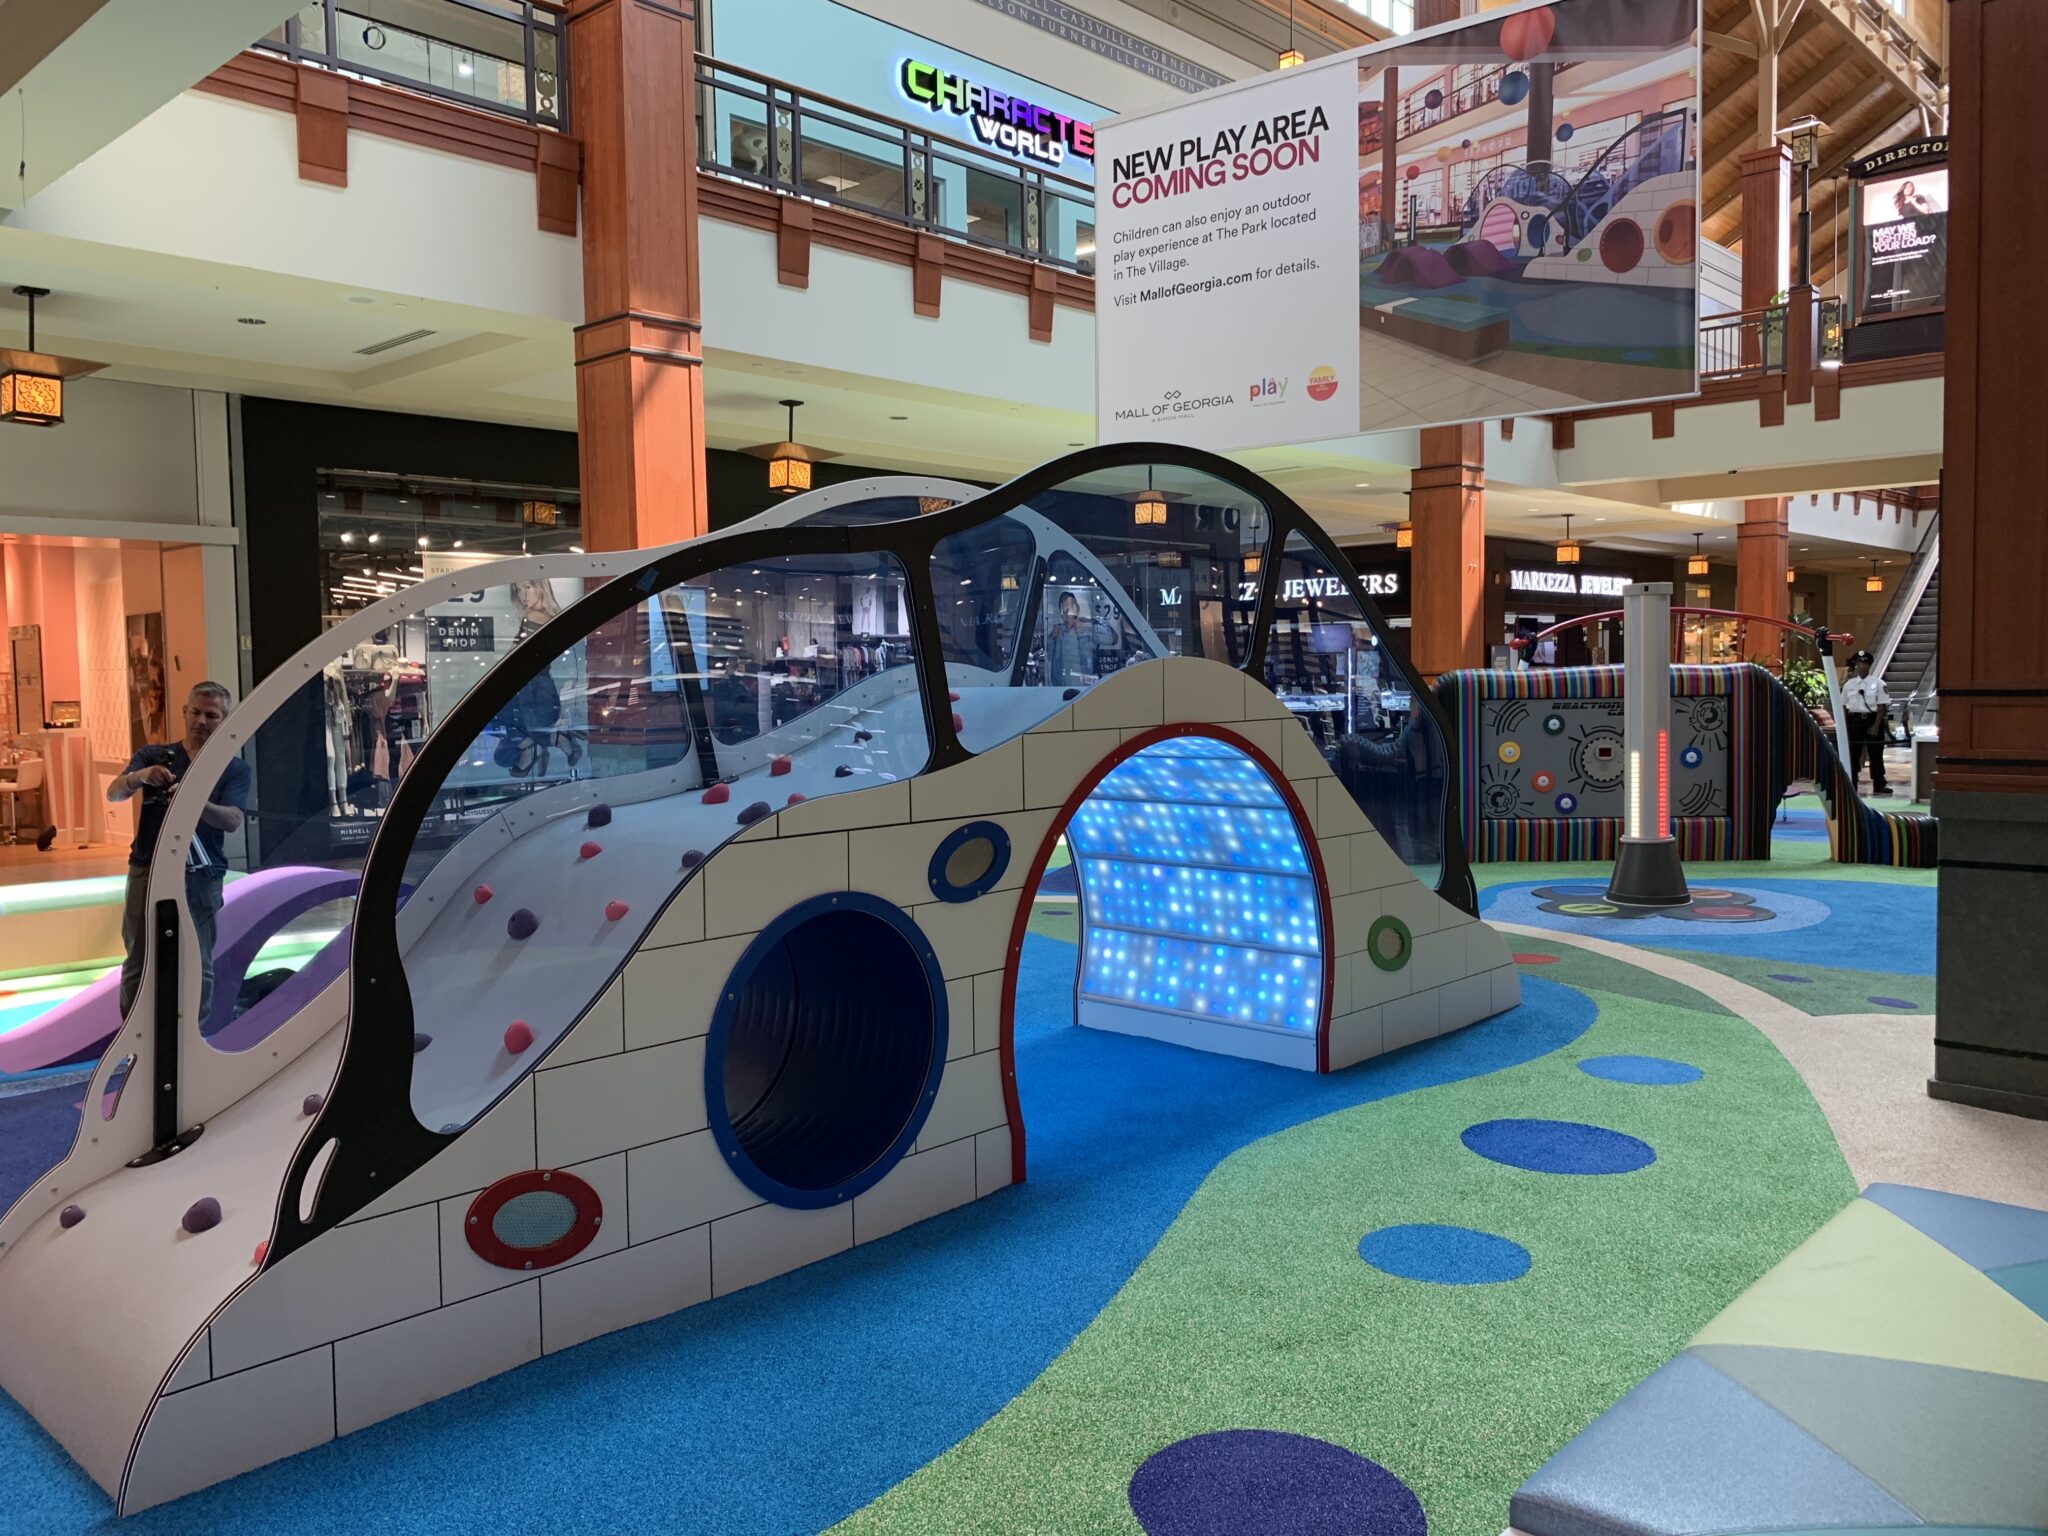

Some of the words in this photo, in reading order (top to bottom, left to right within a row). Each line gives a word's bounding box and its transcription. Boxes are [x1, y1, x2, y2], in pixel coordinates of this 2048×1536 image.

[1040, 17, 1139, 69] TURNERVILLE
[1147, 63, 1195, 92] HIGDON
[1060, 8, 1133, 49] CASSVILLE
[1142, 45, 1206, 82] CORNELIA
[901, 59, 1095, 158] CHARACTE
[974, 114, 1064, 166] WORLD
[1113, 144, 1174, 183] NEW
[1180, 125, 1247, 166] PLAY
[1250, 105, 1329, 149] AREA
[1112, 159, 1226, 208] COMING
[1231, 135, 1320, 181] SOON
[1113, 226, 1159, 244] Children
[1162, 220, 1182, 233] can
[1185, 214, 1207, 228] also
[1210, 207, 1242, 223] enjoy
[1245, 204, 1259, 215] an
[1262, 192, 1312, 211] outdoor
[1873, 225, 1897, 238] MAY
[1897, 222, 1916, 234] WE
[1114, 249, 1135, 265] play
[1138, 236, 1199, 257] experience
[1201, 232, 1213, 244] at
[1216, 227, 1238, 240] The
[1241, 220, 1267, 235] Park
[1270, 208, 1317, 229] located
[1873, 230, 1917, 245] LIGHTEN
[1873, 241, 1900, 253] YOUR
[1901, 234, 1937, 248] LOAD?
[1113, 269, 1123, 281] in
[1126, 265, 1146, 279] The
[1149, 257, 1190, 274] Village.
[1114, 293, 1137, 307] Visit
[1140, 271, 1252, 302] MallofGeorgia.com
[1256, 267, 1272, 280] for
[1275, 257, 1320, 277] details.
[1250, 376, 1288, 402] play
[1309, 375, 1335, 385] FAMILY
[1115, 407, 1149, 421] MALL
[1152, 403, 1170, 415] OF
[1172, 394, 1234, 412] GEORGIA
[1510, 570, 1577, 593] MARKEZZA
[438, 627, 479, 636] DENIM
[442, 638, 477, 648] SHOP
